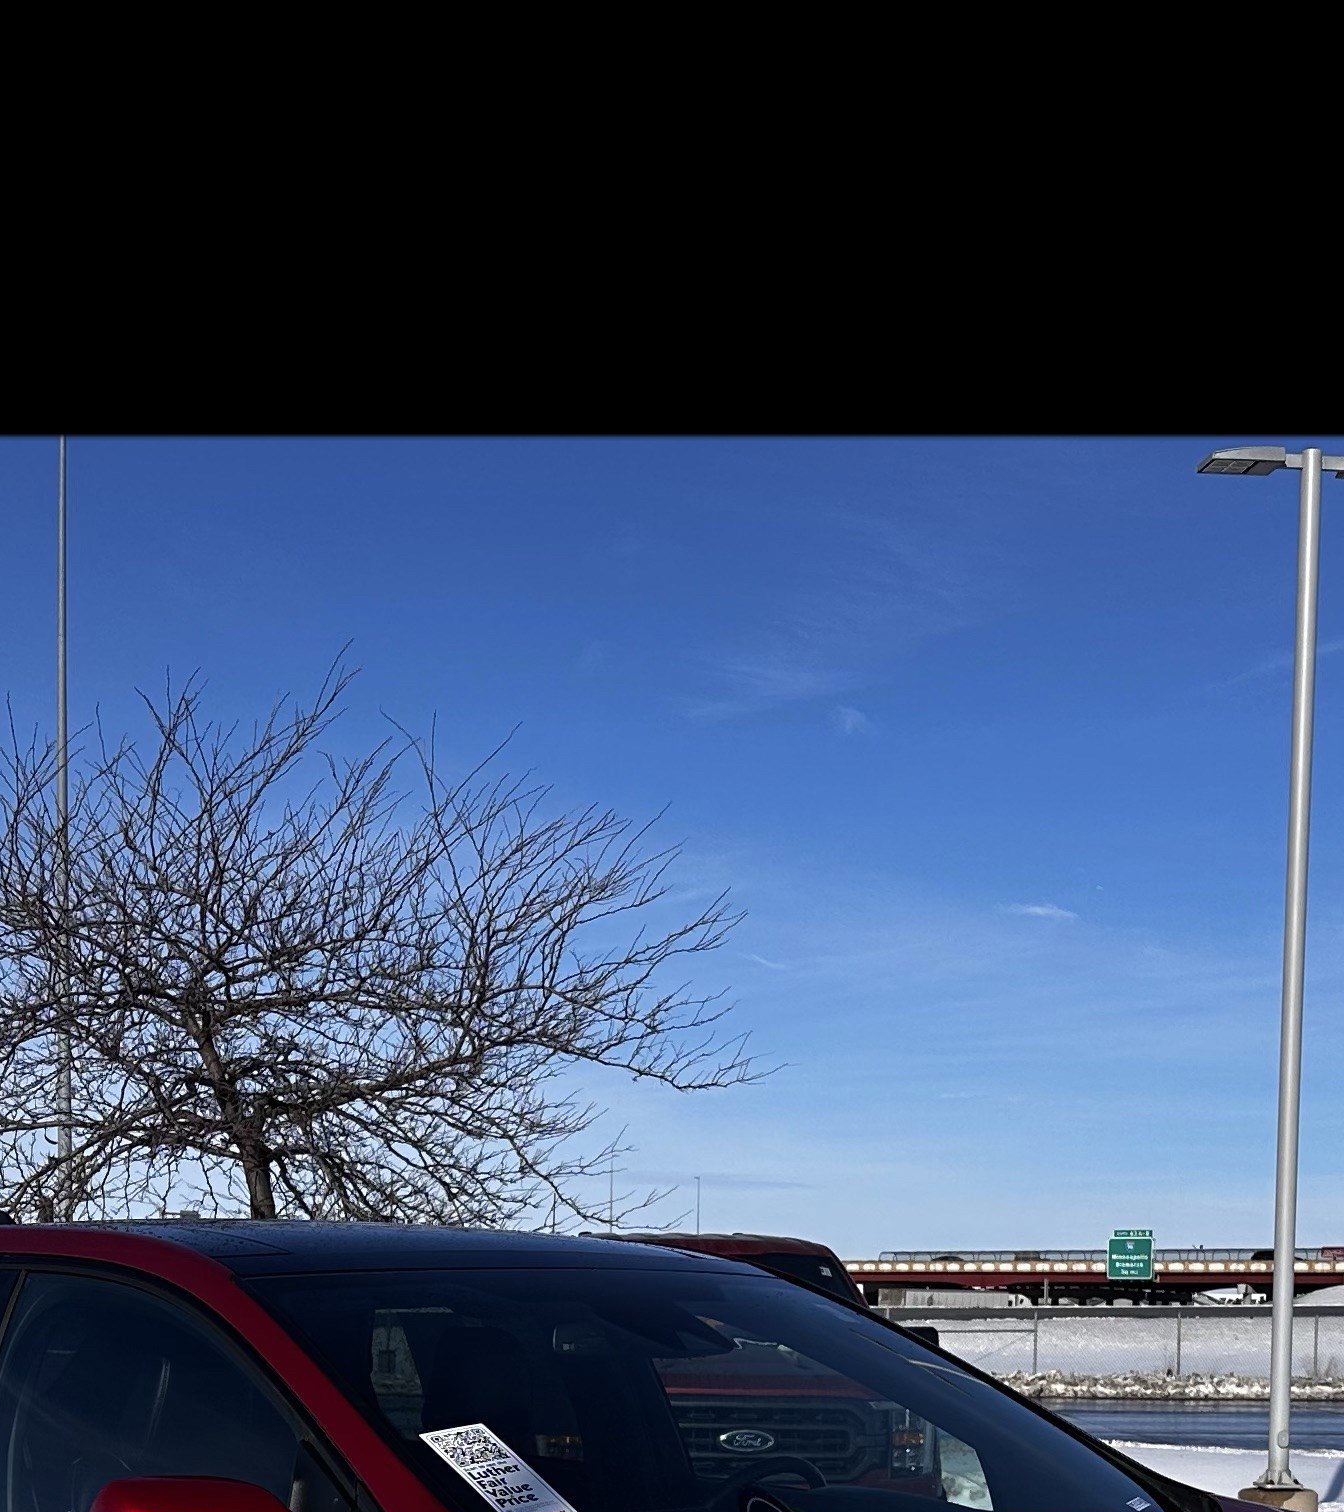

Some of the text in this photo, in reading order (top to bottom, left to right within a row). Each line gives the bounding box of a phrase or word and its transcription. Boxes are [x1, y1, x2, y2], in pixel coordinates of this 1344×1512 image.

[733, 1434, 763, 1447] Ford
[468, 1464, 521, 1481] Luther
[476, 1477, 507, 1490] Fair
[485, 1483, 533, 1498] Value
[495, 1493, 538, 1508] Price
